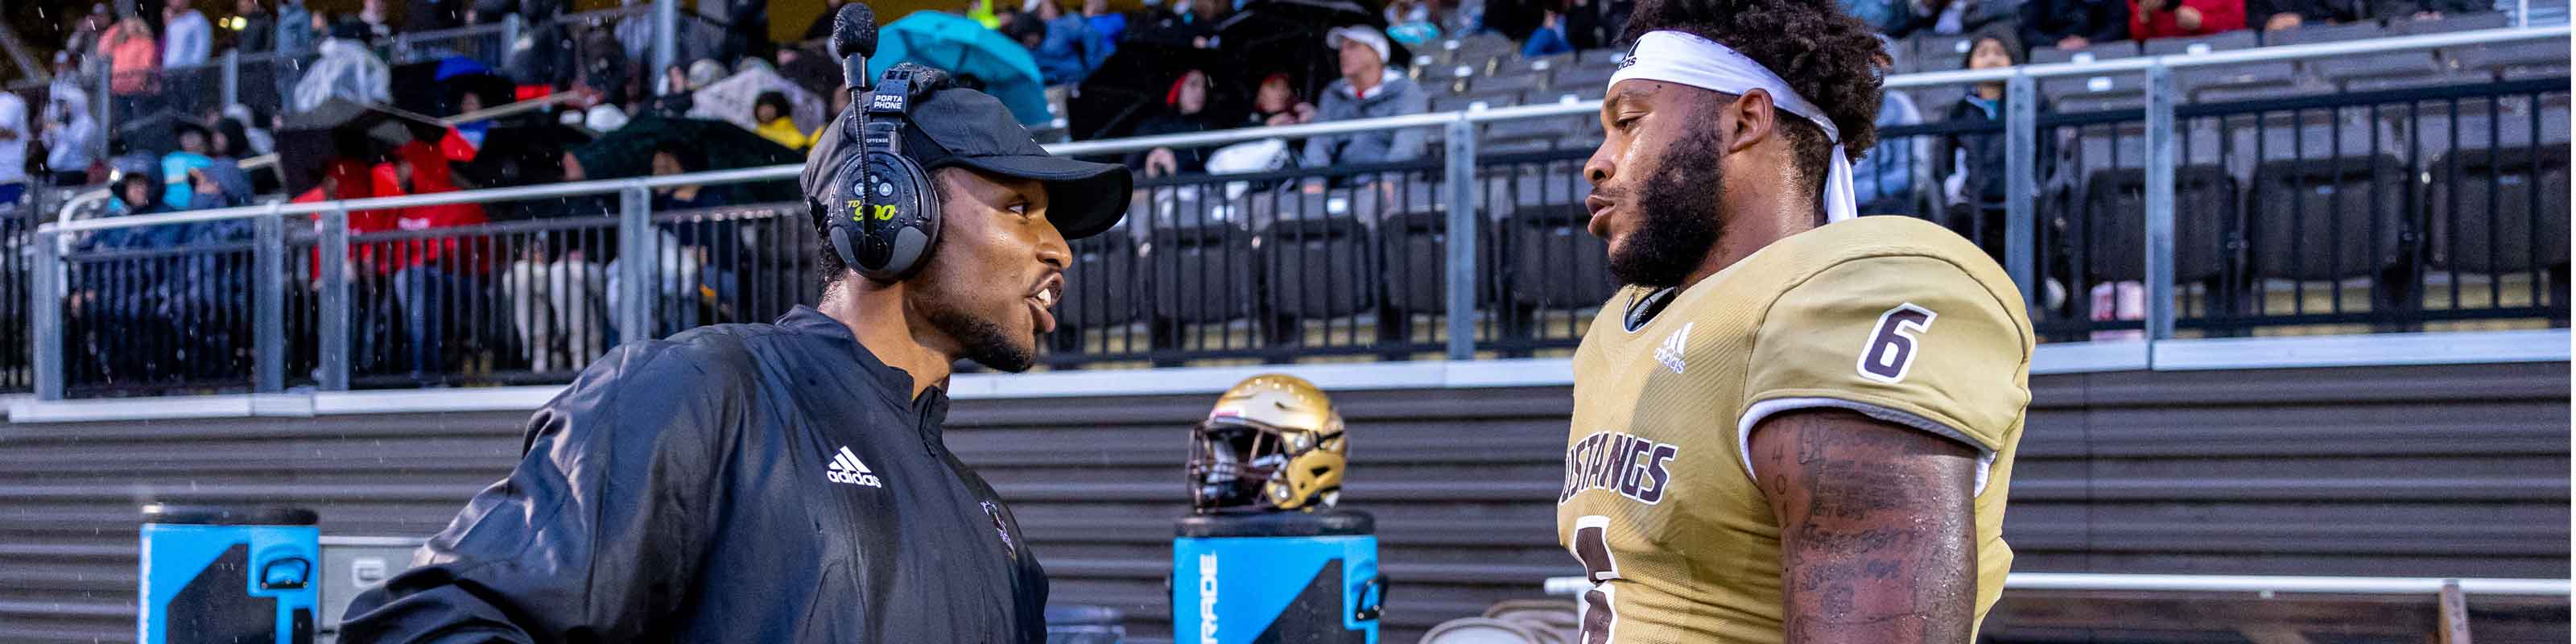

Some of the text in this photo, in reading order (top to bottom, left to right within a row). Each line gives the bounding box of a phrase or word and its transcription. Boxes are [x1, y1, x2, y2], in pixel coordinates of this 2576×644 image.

[874, 101, 902, 109] PHONE
[848, 200, 861, 208] TD
[1856, 302, 1938, 383] 6
[827, 467, 881, 488] adidas
[1559, 430, 1678, 506] USTANGS
[1199, 553, 1218, 644] RADE
